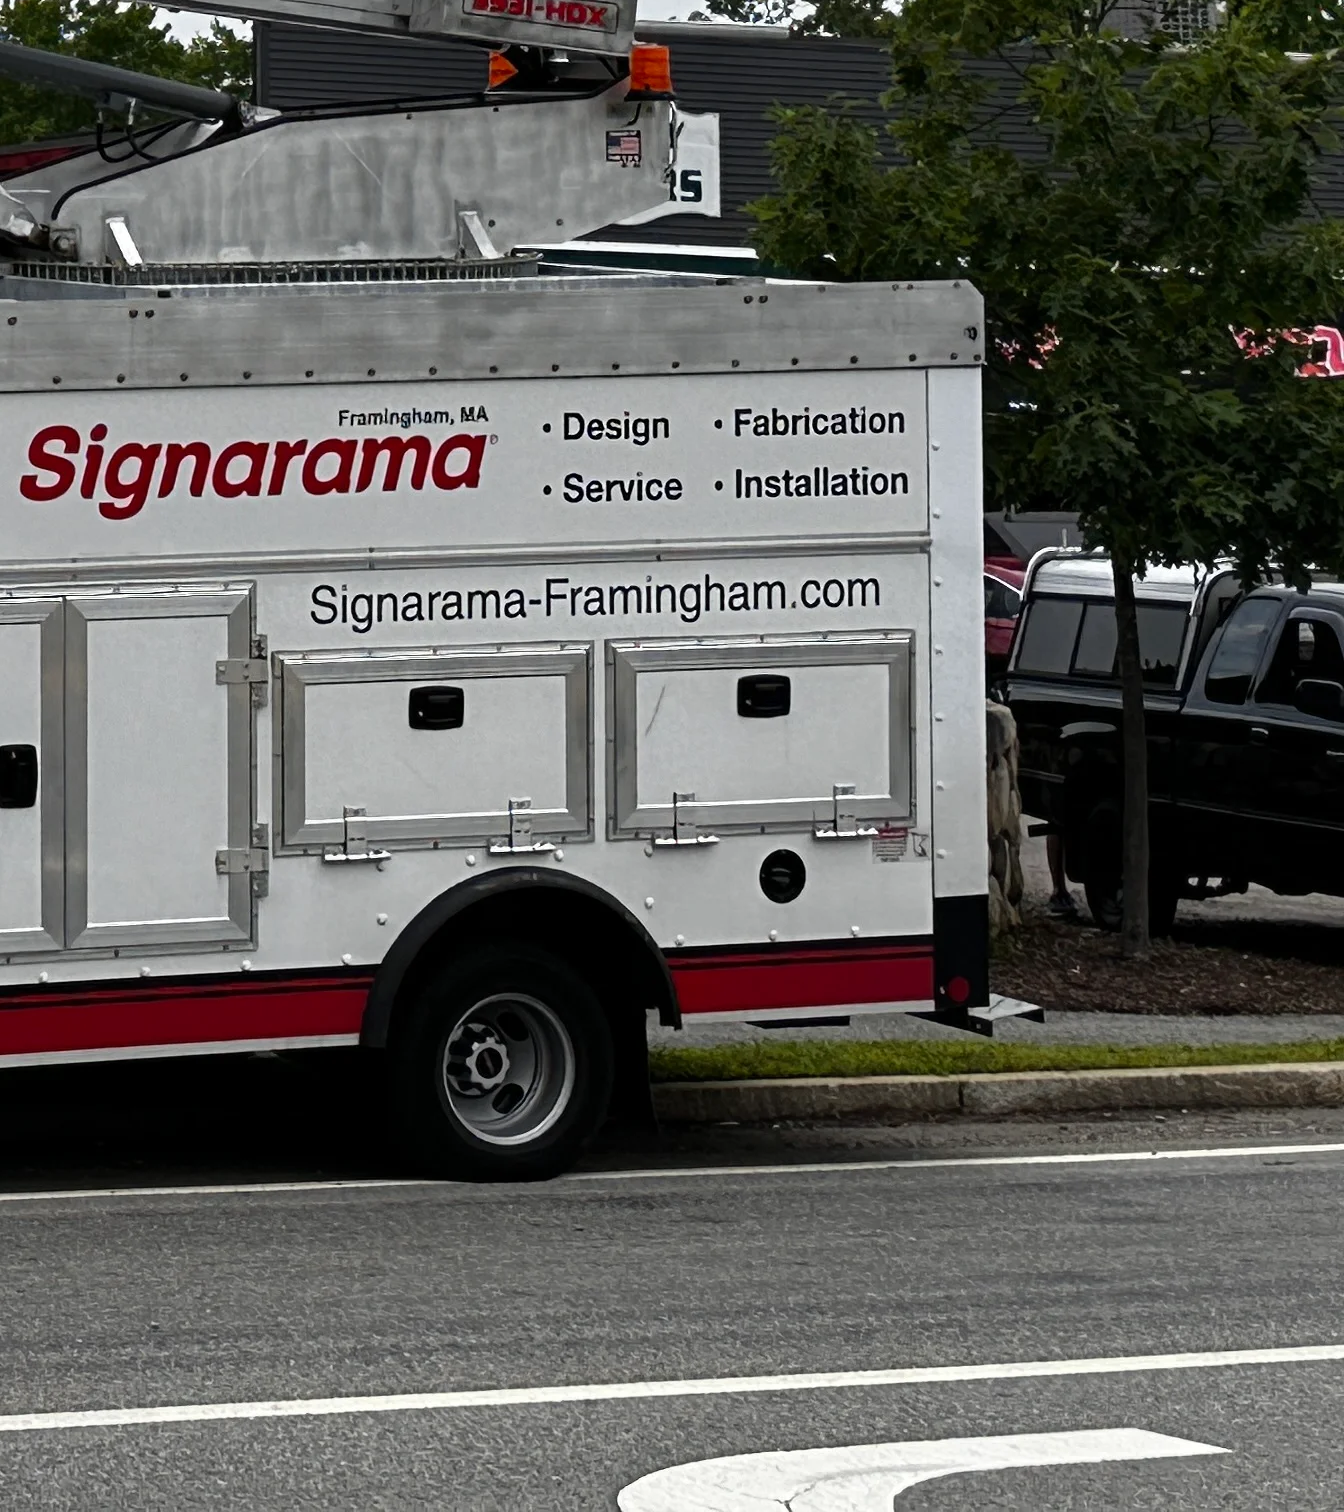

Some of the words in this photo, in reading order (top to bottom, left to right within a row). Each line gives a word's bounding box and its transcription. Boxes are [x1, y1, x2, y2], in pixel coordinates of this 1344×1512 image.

[338, 407, 455, 429] Framingham,
[460, 405, 489, 423] MA
[562, 411, 670, 446] Design
[734, 406, 906, 437] Fabrication
[19, 423, 489, 521] Signarama
[562, 471, 684, 504] Service
[734, 467, 909, 500] Installation
[309, 574, 881, 634] Signarama-Framingham.com
